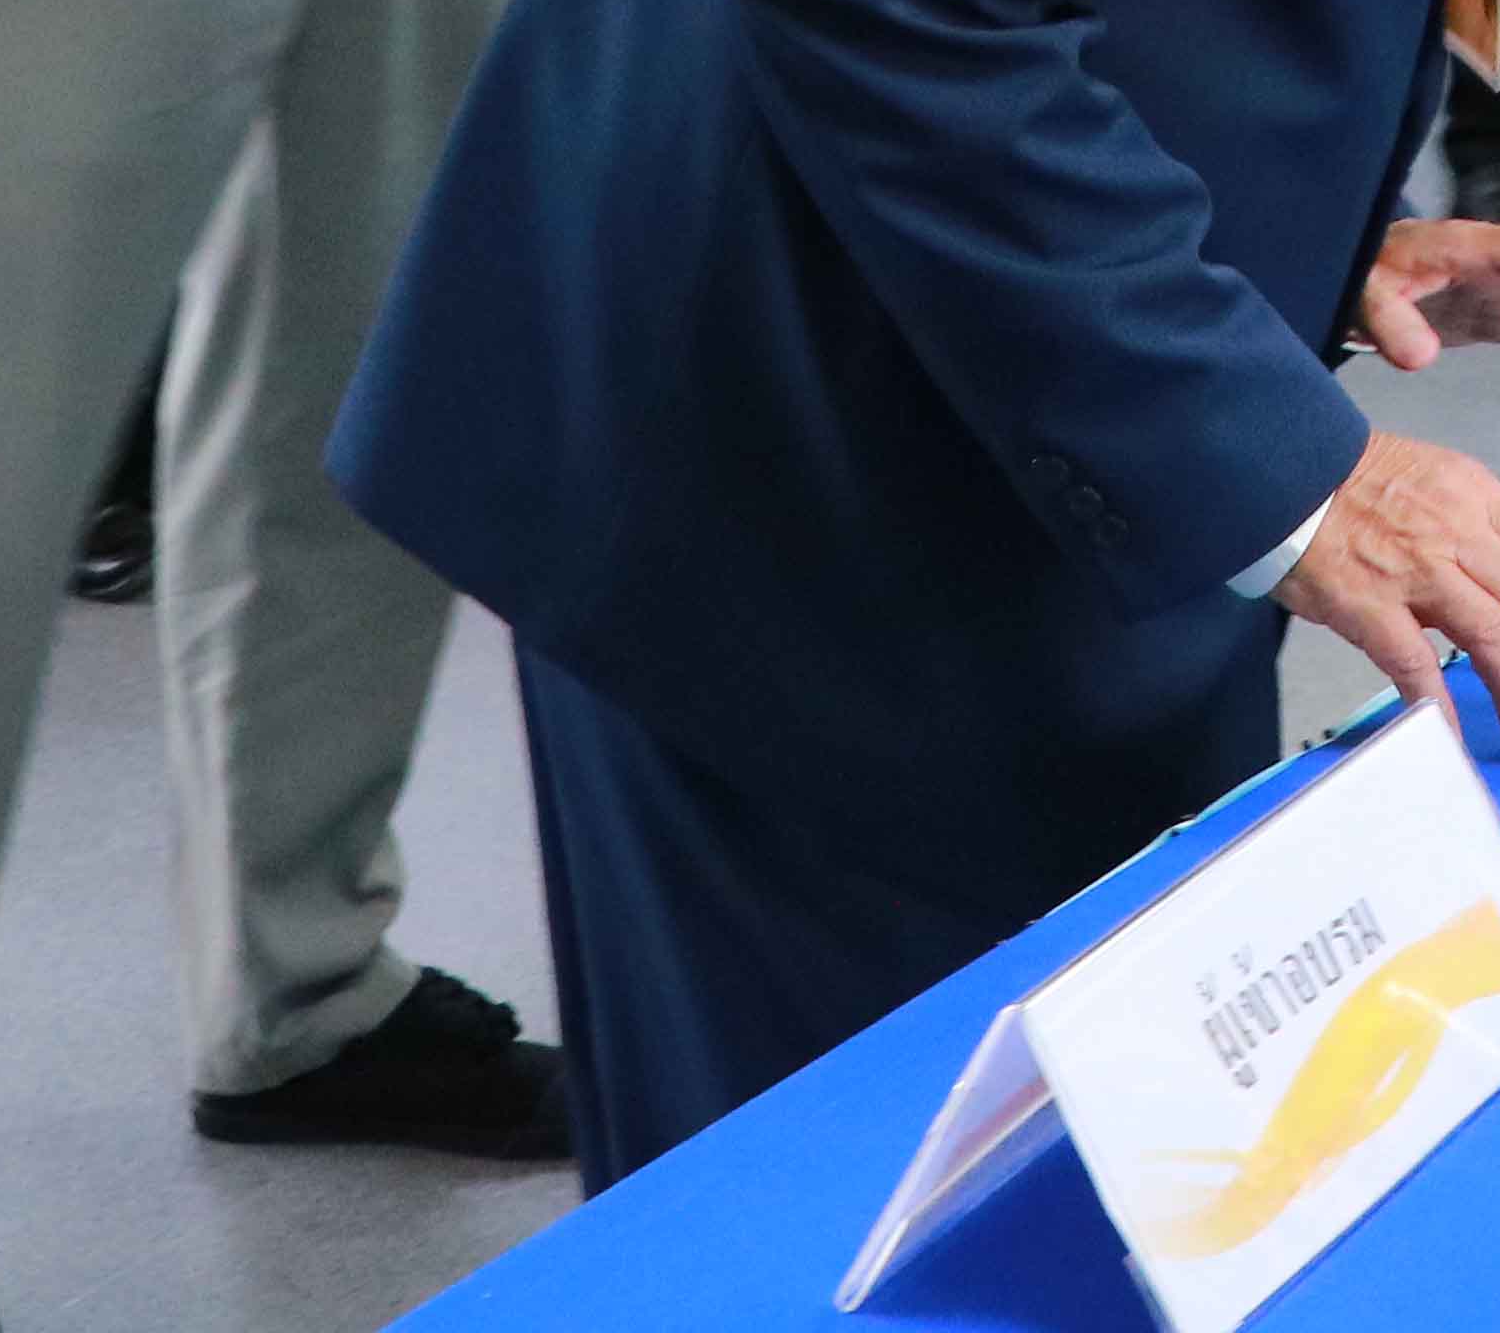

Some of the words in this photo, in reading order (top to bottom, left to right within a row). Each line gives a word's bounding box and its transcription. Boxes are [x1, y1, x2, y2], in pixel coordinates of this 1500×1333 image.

[1195, 896, 1387, 1090] ผู้เข้าอบรม
